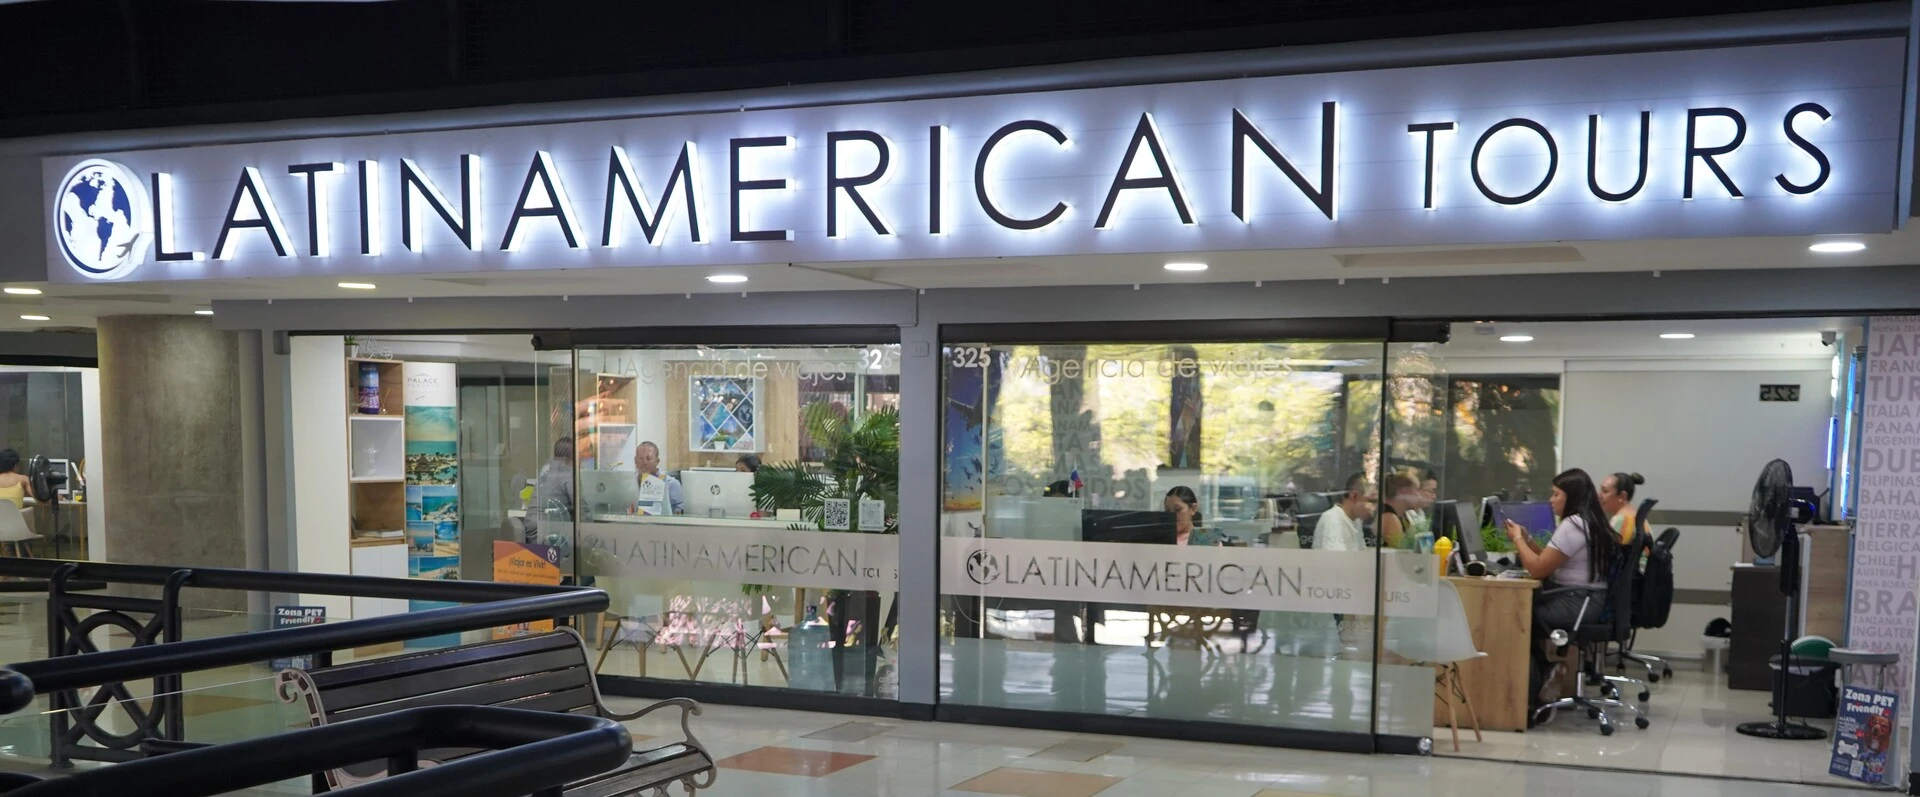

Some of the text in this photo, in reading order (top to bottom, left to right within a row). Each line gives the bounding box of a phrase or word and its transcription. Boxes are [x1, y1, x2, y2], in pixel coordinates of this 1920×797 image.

[151, 101, 1832, 263] LATINAMERICAN TOURS
[952, 347, 991, 368] 325
[625, 356, 847, 386] Agencia de viajes
[1021, 352, 1293, 385] Agencia de viajes
[1866, 404, 1911, 418] ITALIA
[1856, 554, 1897, 567] CHILE
[1004, 553, 1352, 600] LATINAMERICAN TOURS
[1385, 591, 1411, 603] URS
[278, 608, 323, 616] Zona PET
[280, 616, 316, 625] Friendly
[1845, 688, 1872, 703] Zona
[1873, 694, 1895, 708] PET
[1846, 702, 1884, 716] Friendly
